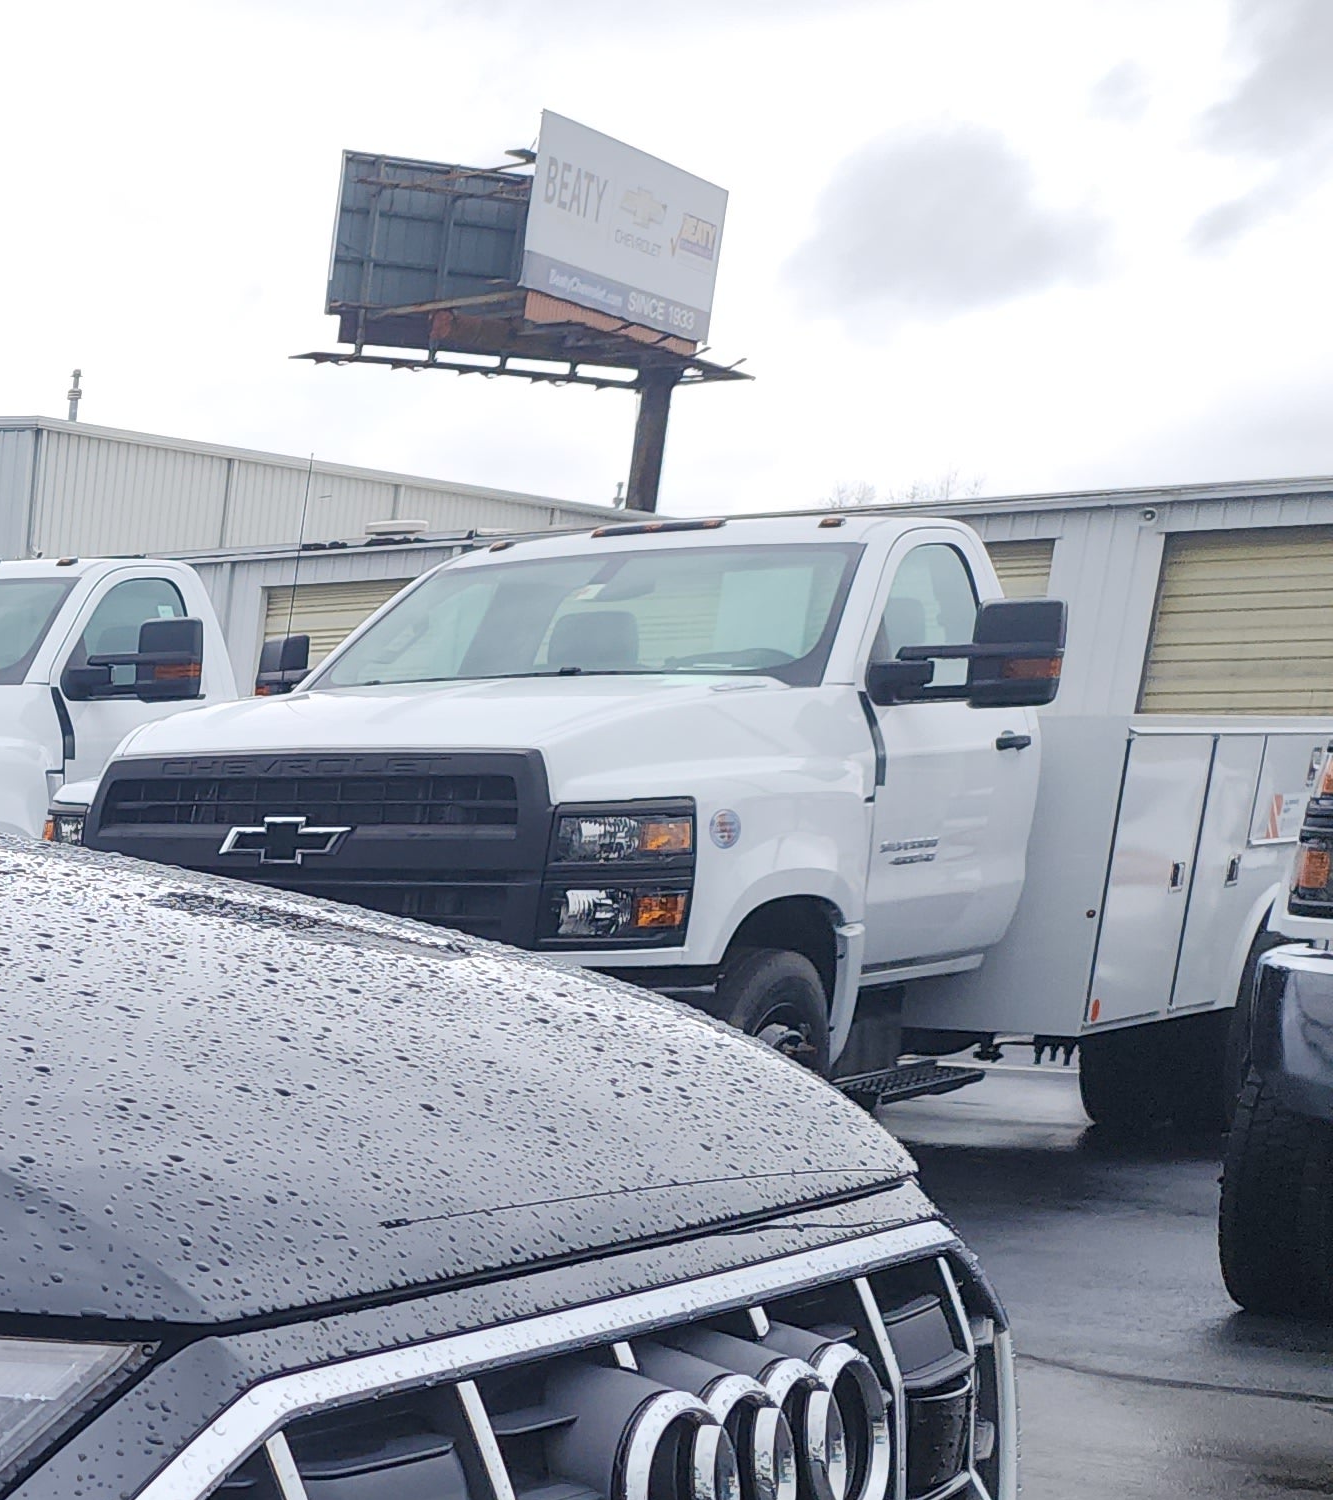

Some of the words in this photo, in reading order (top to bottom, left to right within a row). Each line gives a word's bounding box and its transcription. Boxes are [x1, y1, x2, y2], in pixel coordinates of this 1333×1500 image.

[544, 155, 609, 224] BEATY
[627, 291, 666, 321] SINCE
[668, 305, 695, 331] 1933
[162, 757, 451, 776] CHEVROLET
